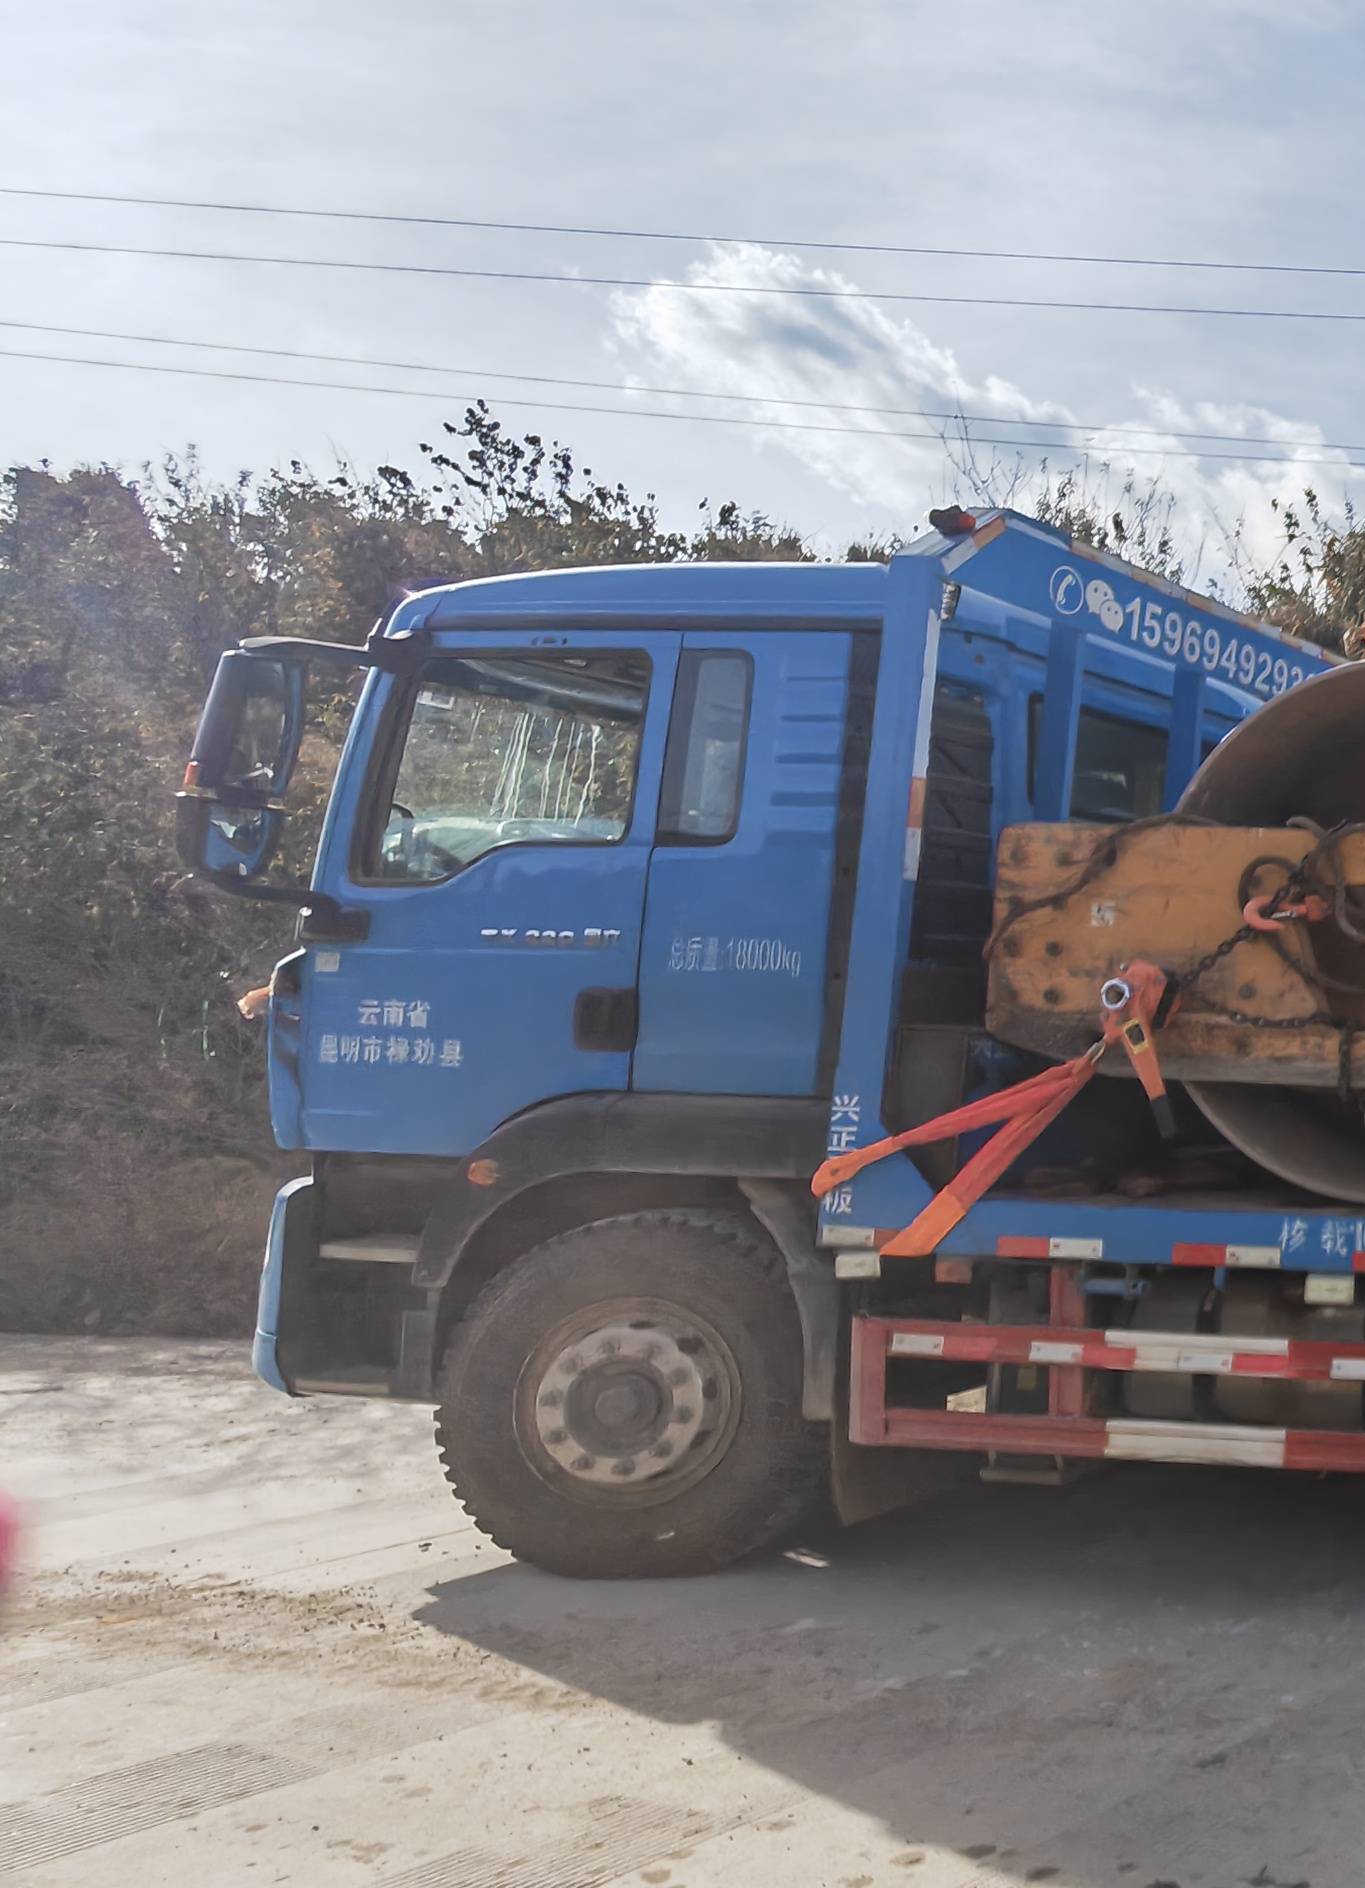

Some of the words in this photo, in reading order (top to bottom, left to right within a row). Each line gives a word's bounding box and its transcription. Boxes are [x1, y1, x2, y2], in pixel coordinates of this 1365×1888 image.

[358, 1000, 430, 1028] 云南省
[824, 1094, 860, 1214] 兴正板
